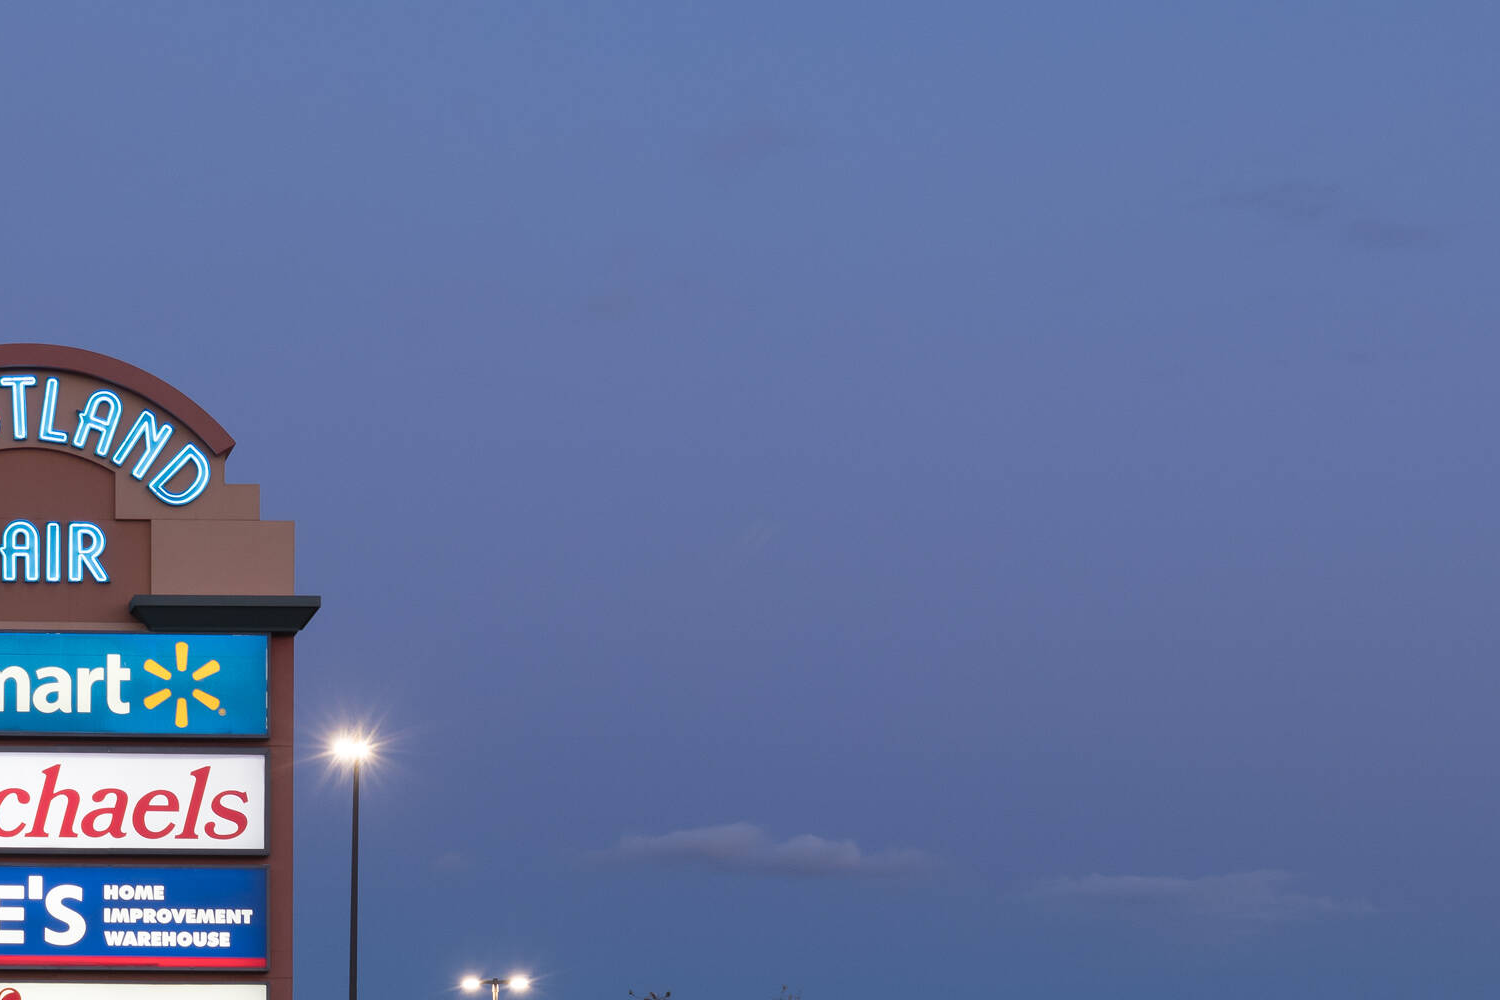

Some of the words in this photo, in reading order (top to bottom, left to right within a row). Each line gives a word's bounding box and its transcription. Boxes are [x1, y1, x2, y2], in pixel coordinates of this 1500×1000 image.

[103, 884, 165, 901] HOME
[103, 907, 254, 926] IMPROVEMENT
[103, 930, 231, 948] WAREHOUSE
